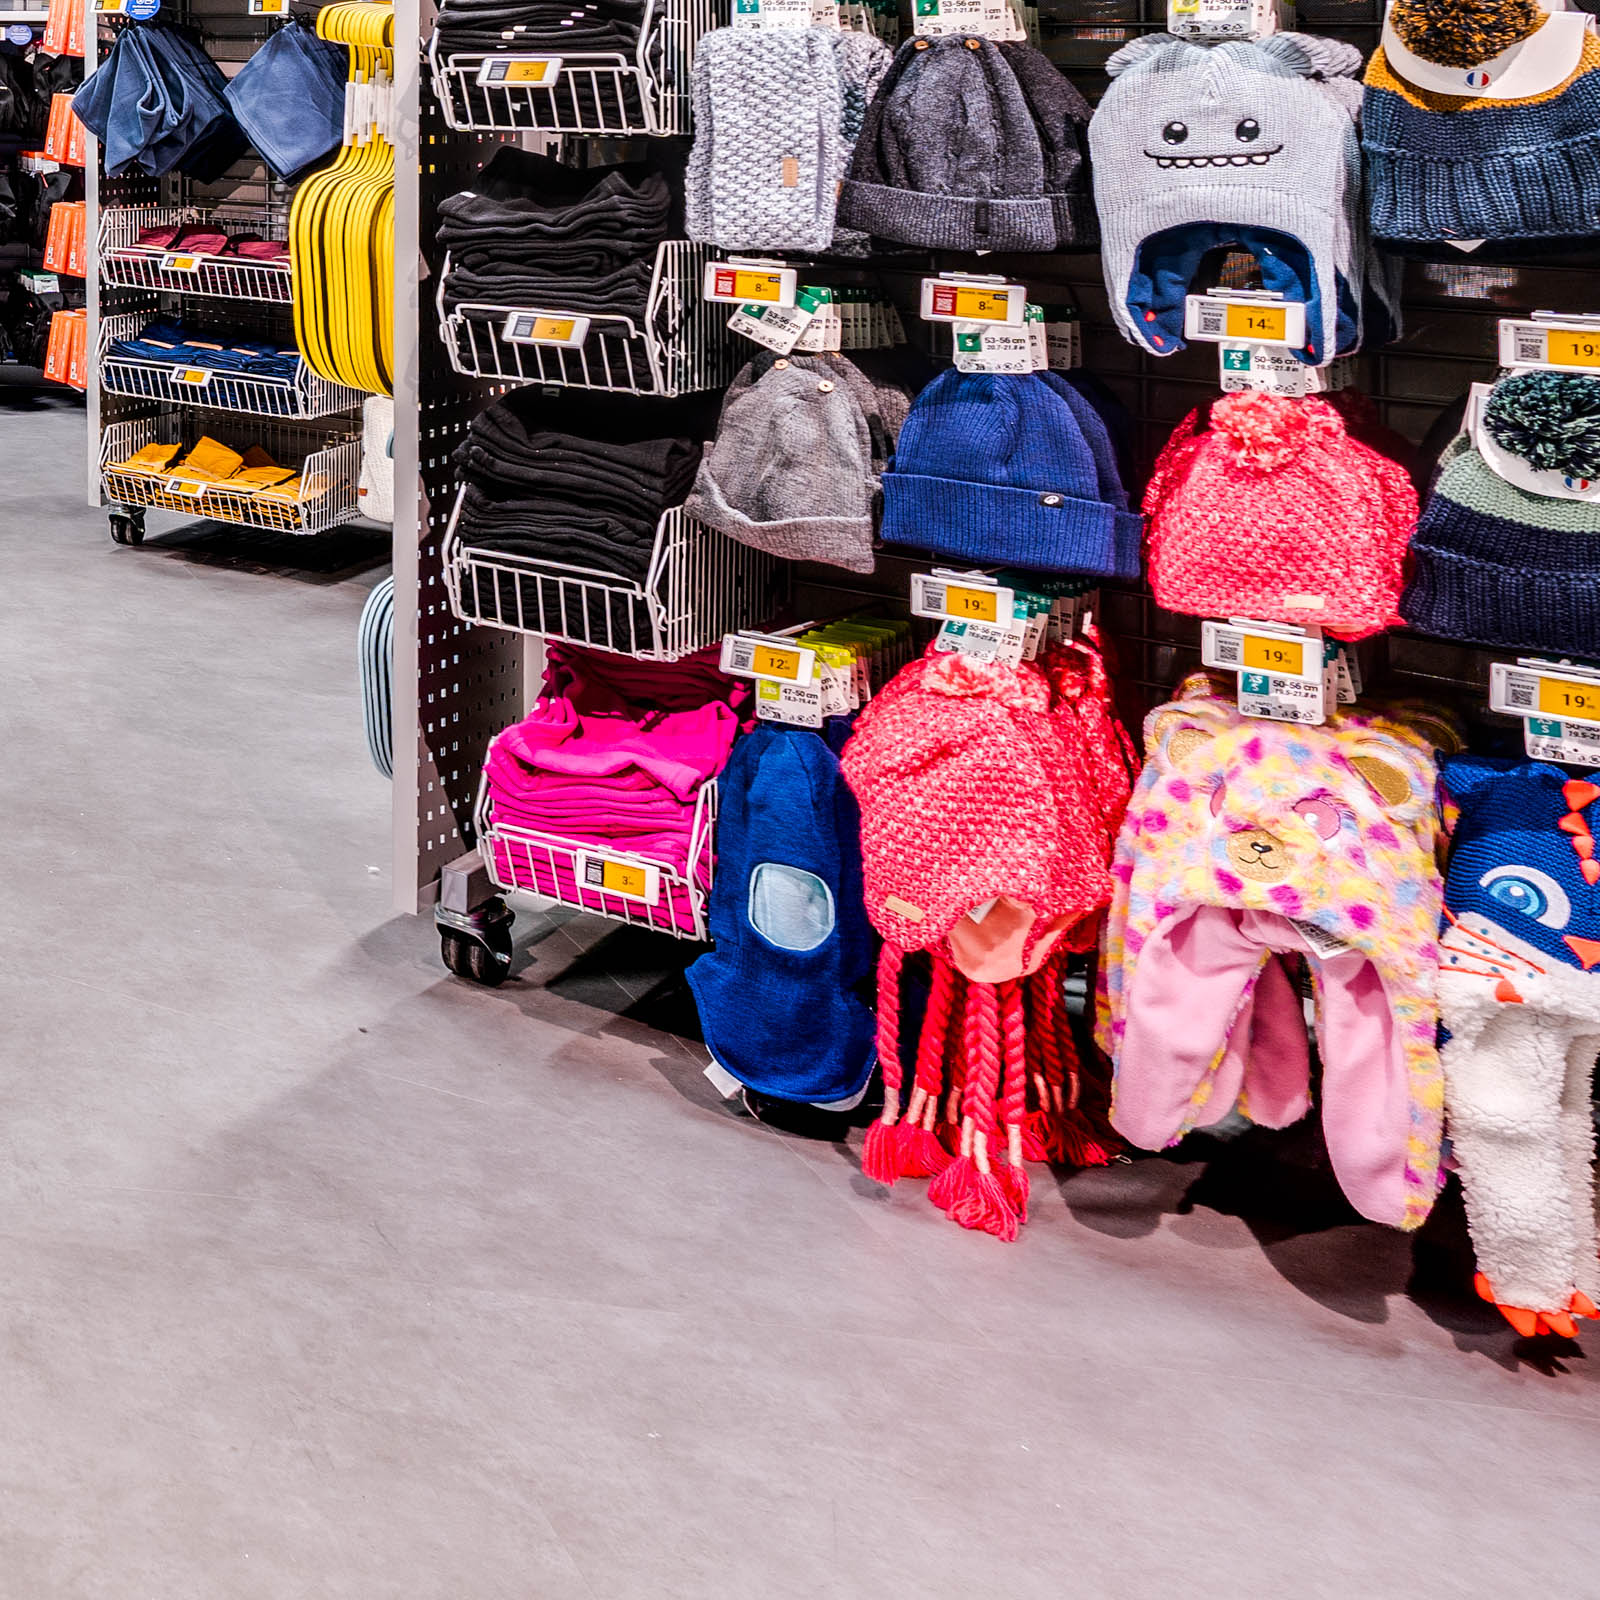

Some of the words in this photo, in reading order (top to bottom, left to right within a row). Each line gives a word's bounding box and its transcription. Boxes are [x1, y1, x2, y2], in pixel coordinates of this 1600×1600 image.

[924, 3, 931, 11] S
[767, 310, 789, 325] 53-56
[789, 322, 801, 330] cm
[1229, 352, 1243, 360] XS
[1233, 360, 1240, 368] S
[1254, 356, 1283, 364] 50-56
[1284, 357, 1300, 365] cm
[1251, 684, 1259, 692] S
[1272, 680, 1302, 690] 50-56
[1303, 684, 1319, 692] cm
[782, 688, 806, 698] 47-50
[1541, 725, 1549, 733] S
